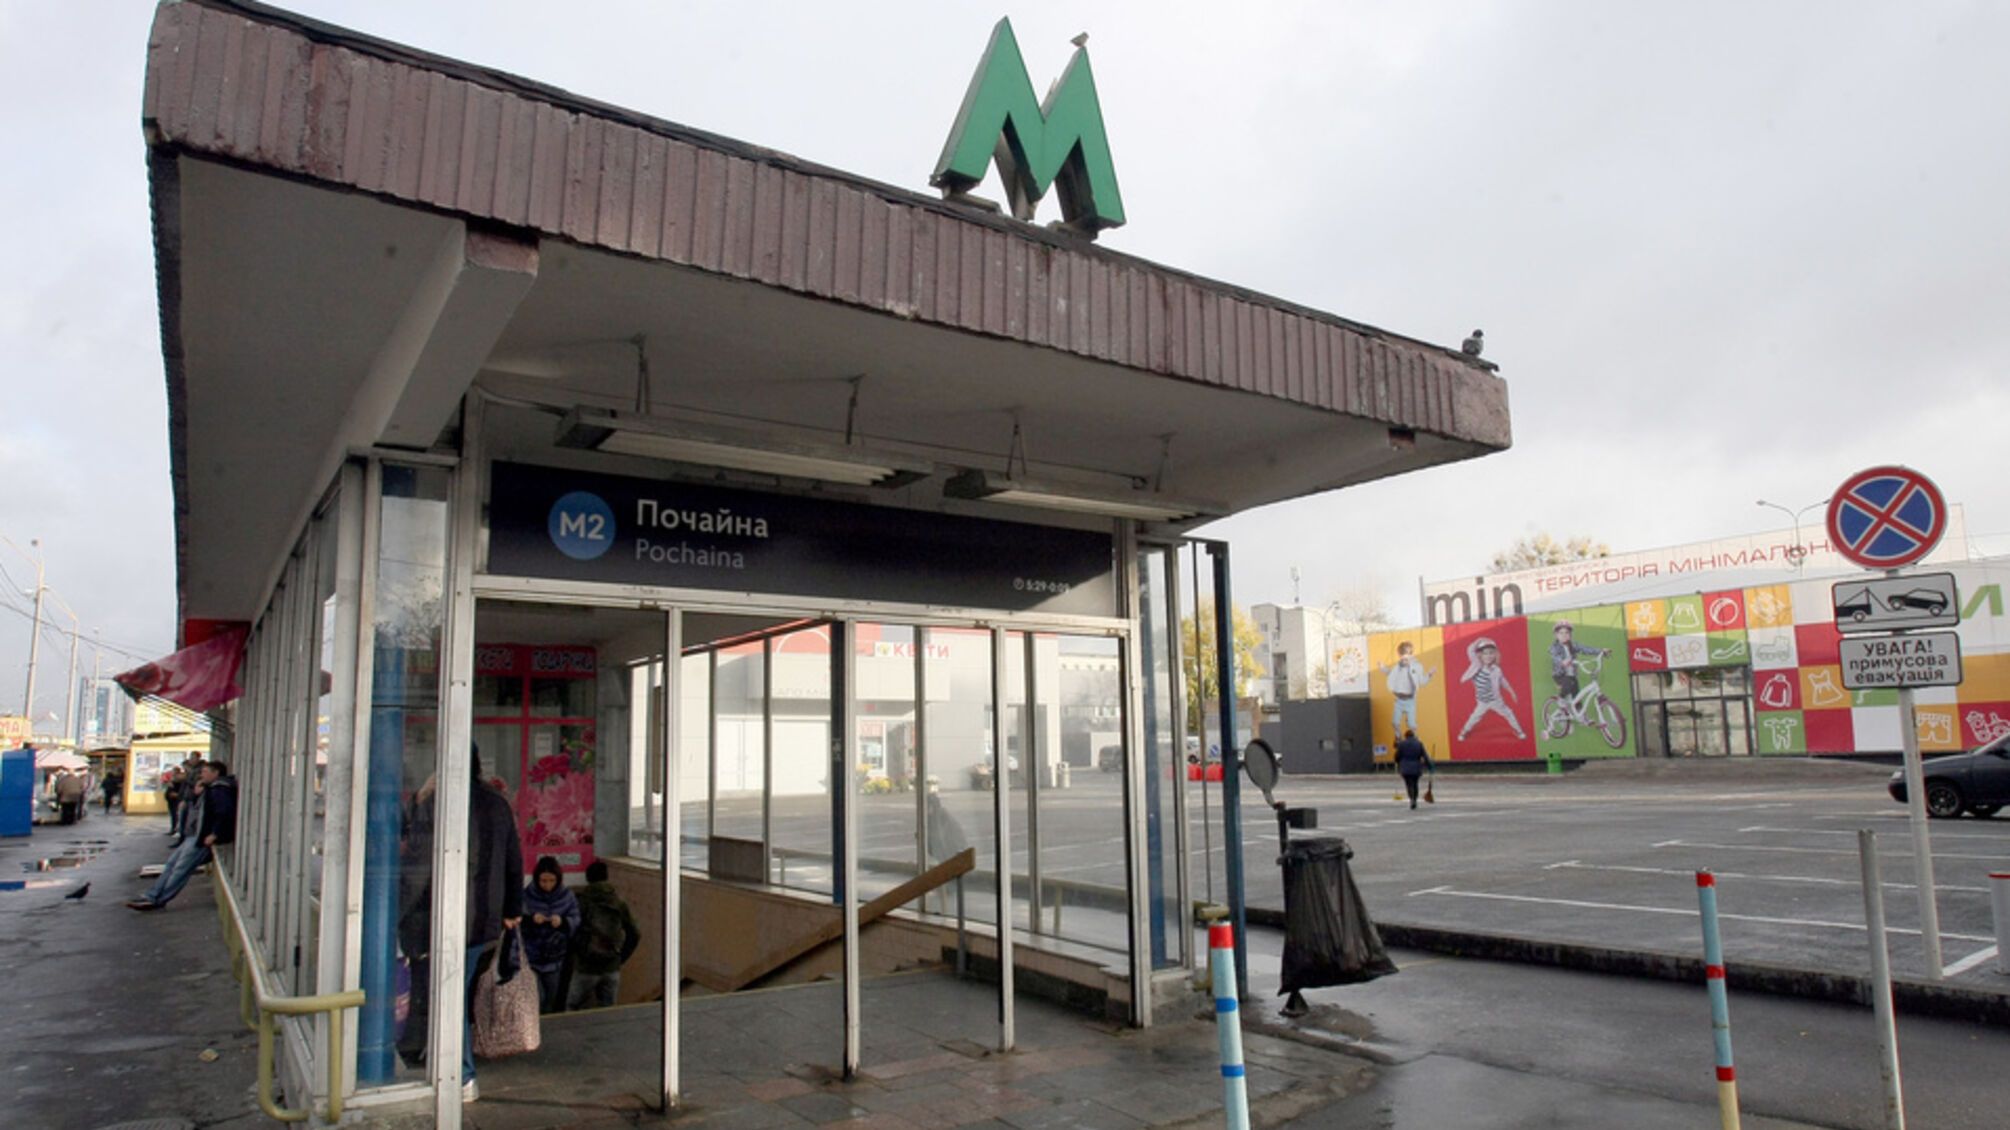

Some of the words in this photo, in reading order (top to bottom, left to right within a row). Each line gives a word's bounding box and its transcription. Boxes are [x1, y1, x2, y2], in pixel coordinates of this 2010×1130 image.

[559, 511, 605, 540] М2
[636, 499, 769, 537] Почайна
[635, 538, 744, 568] Pochaina
[1534, 563, 1659, 592] ТЕРИТОРІЯ
[1669, 540, 1839, 573] МІНІМАЛЬН
[1427, 576, 1522, 625] min
[1863, 639, 1933, 657] УВАГА!
[1850, 654, 1949, 673] примусова
[1855, 668, 1944, 685] евакуація
